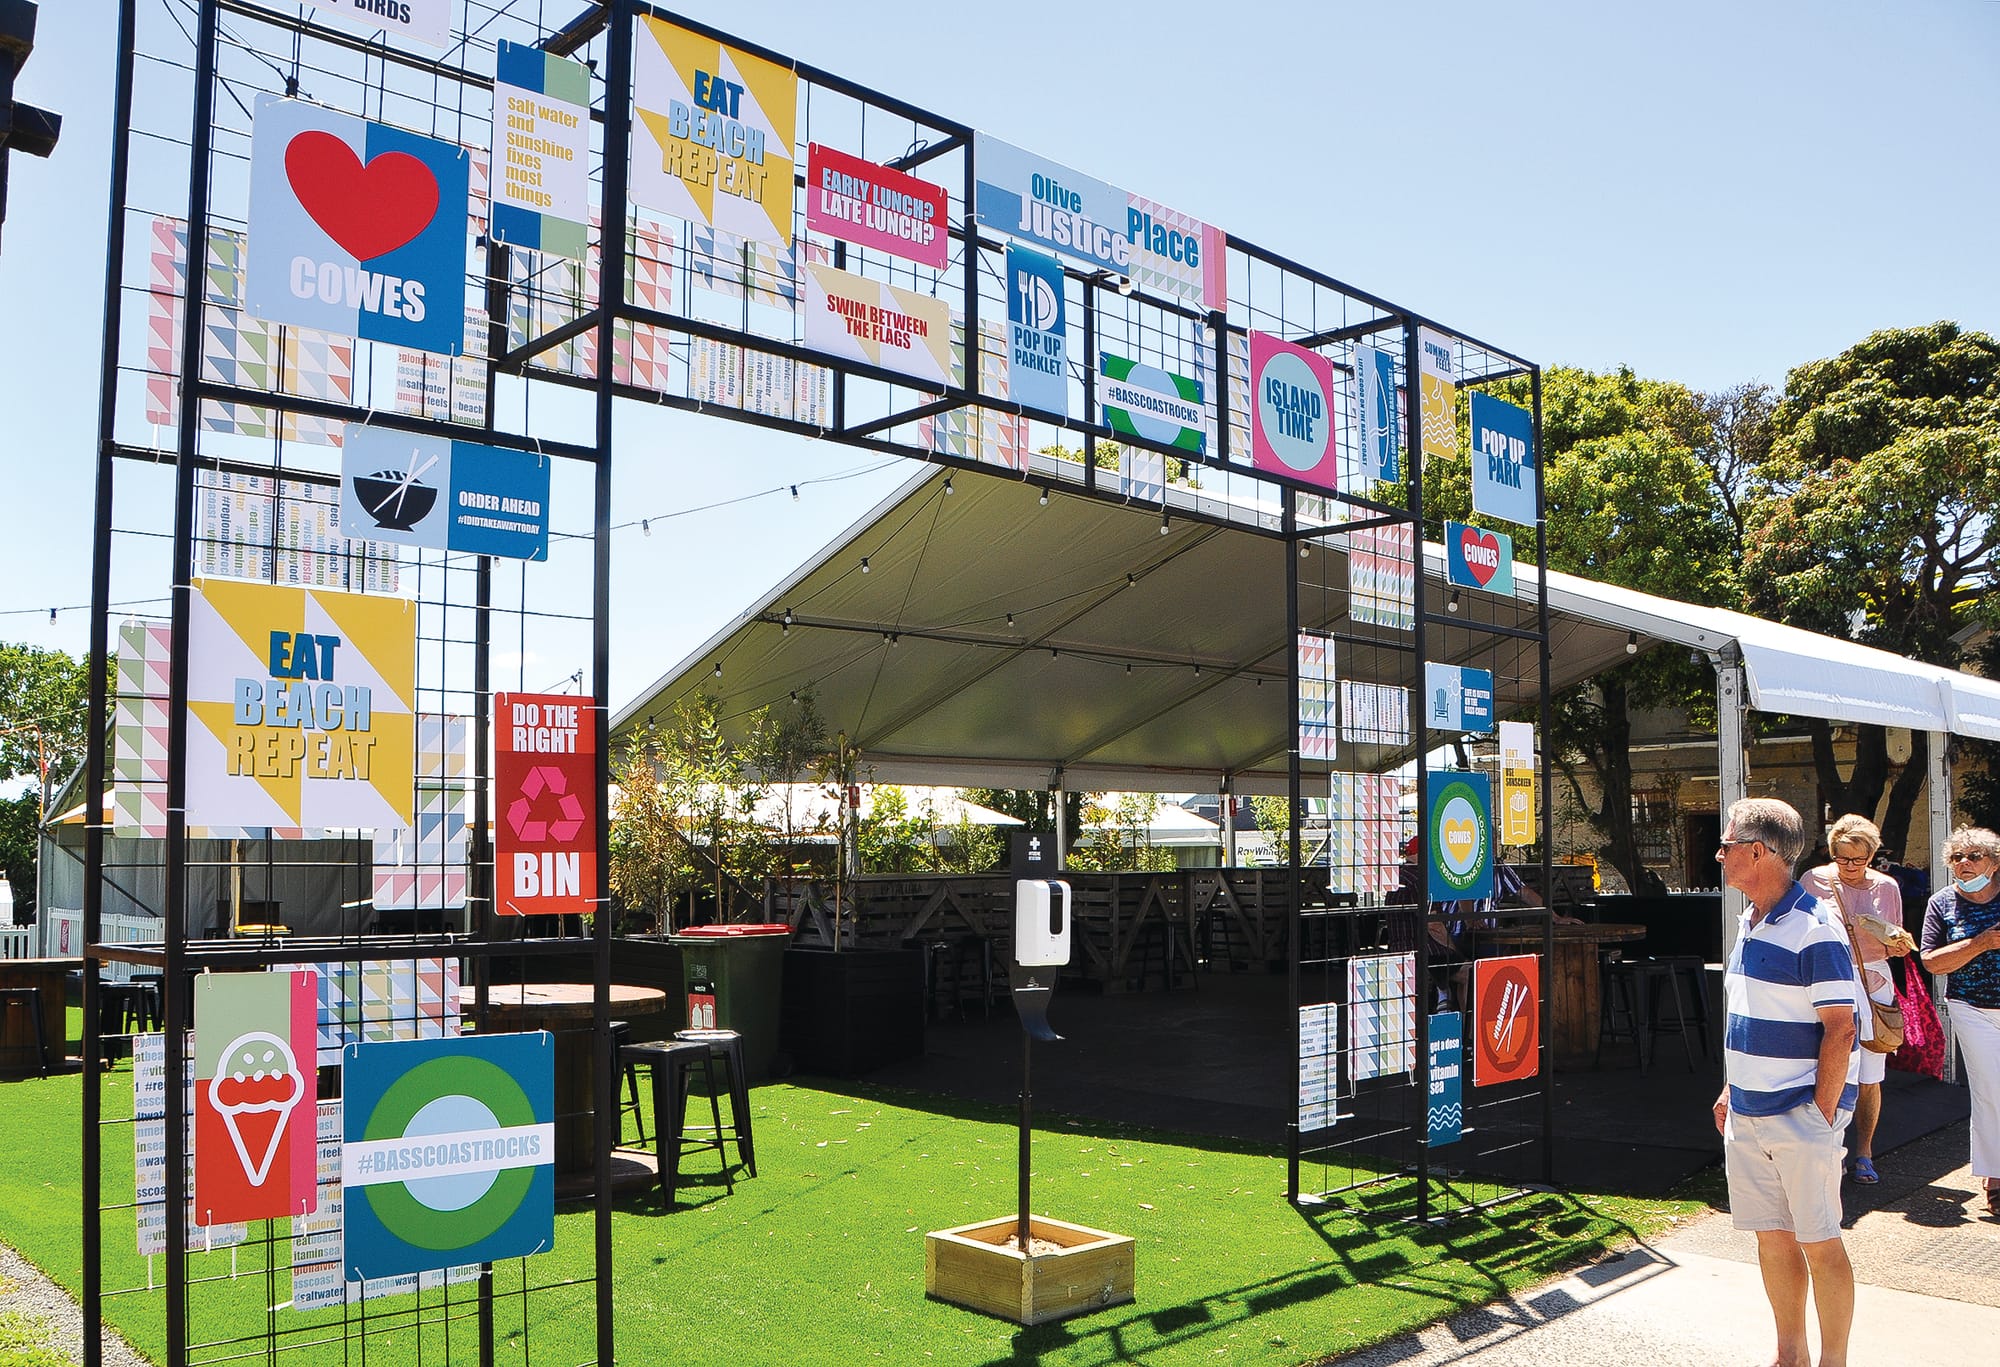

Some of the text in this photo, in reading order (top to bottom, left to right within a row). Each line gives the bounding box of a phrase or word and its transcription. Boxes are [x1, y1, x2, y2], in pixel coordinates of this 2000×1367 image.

[694, 69, 744, 120] EAT
[506, 113, 535, 134] and
[507, 95, 579, 129] salt water
[506, 131, 573, 161] sunshine
[669, 99, 765, 167] BEACH
[506, 147, 542, 170] fixes
[662, 141, 767, 204] REPEAT
[506, 166, 542, 187] most
[505, 182, 552, 208] things
[823, 167, 935, 222] EARLY LUNCH?
[1031, 172, 1082, 214] Olive
[821, 189, 935, 246] LATE LUNCH?
[1019, 191, 1199, 268] Justice Place
[289, 256, 426, 323] COWES
[827, 294, 928, 338] SWIM BETWEEN
[845, 316, 911, 350] THE FLAGS
[1014, 325, 1061, 357] POP UP
[1014, 350, 1061, 377] PARKLET
[1424, 341, 1450, 361] SUMMER
[1435, 357, 1451, 374] FEELS
[1108, 385, 1198, 424] #BASSCOASTROCKS
[1266, 377, 1321, 419] ISLAND
[1360, 398, 1366, 409] ON
[1275, 407, 1314, 443] TIME
[1390, 423, 1396, 434] ON
[1481, 427, 1526, 465] POP UP
[1488, 456, 1522, 489] PARK
[458, 490, 540, 517] ORDER AHEAD
[458, 515, 540, 535] #IDIDTAKEAWAYTODAY
[1464, 541, 1498, 568] COWES
[270, 631, 341, 681] EAT
[234, 678, 371, 733] BEACH
[512, 703, 578, 729] DO THE
[227, 729, 376, 781] REPEAT
[512, 727, 578, 754] RIGHT
[1505, 768, 1515, 777] USE
[1505, 778, 1532, 787] SUNSCREEN
[1448, 831, 1472, 844] COWES
[1478, 814, 1486, 847] LOCAL
[1475, 847, 1484, 868] AND
[513, 852, 580, 898] BIN
[1493, 979, 1513, 1040] #takeaway
[1429, 1041, 1440, 1054] get
[1445, 1037, 1460, 1050] dose
[1430, 1054, 1437, 1066] of
[1430, 1063, 1459, 1082] vitamin
[1430, 1081, 1445, 1095] sea
[358, 1134, 541, 1175] #BASSCOASTROCKS
